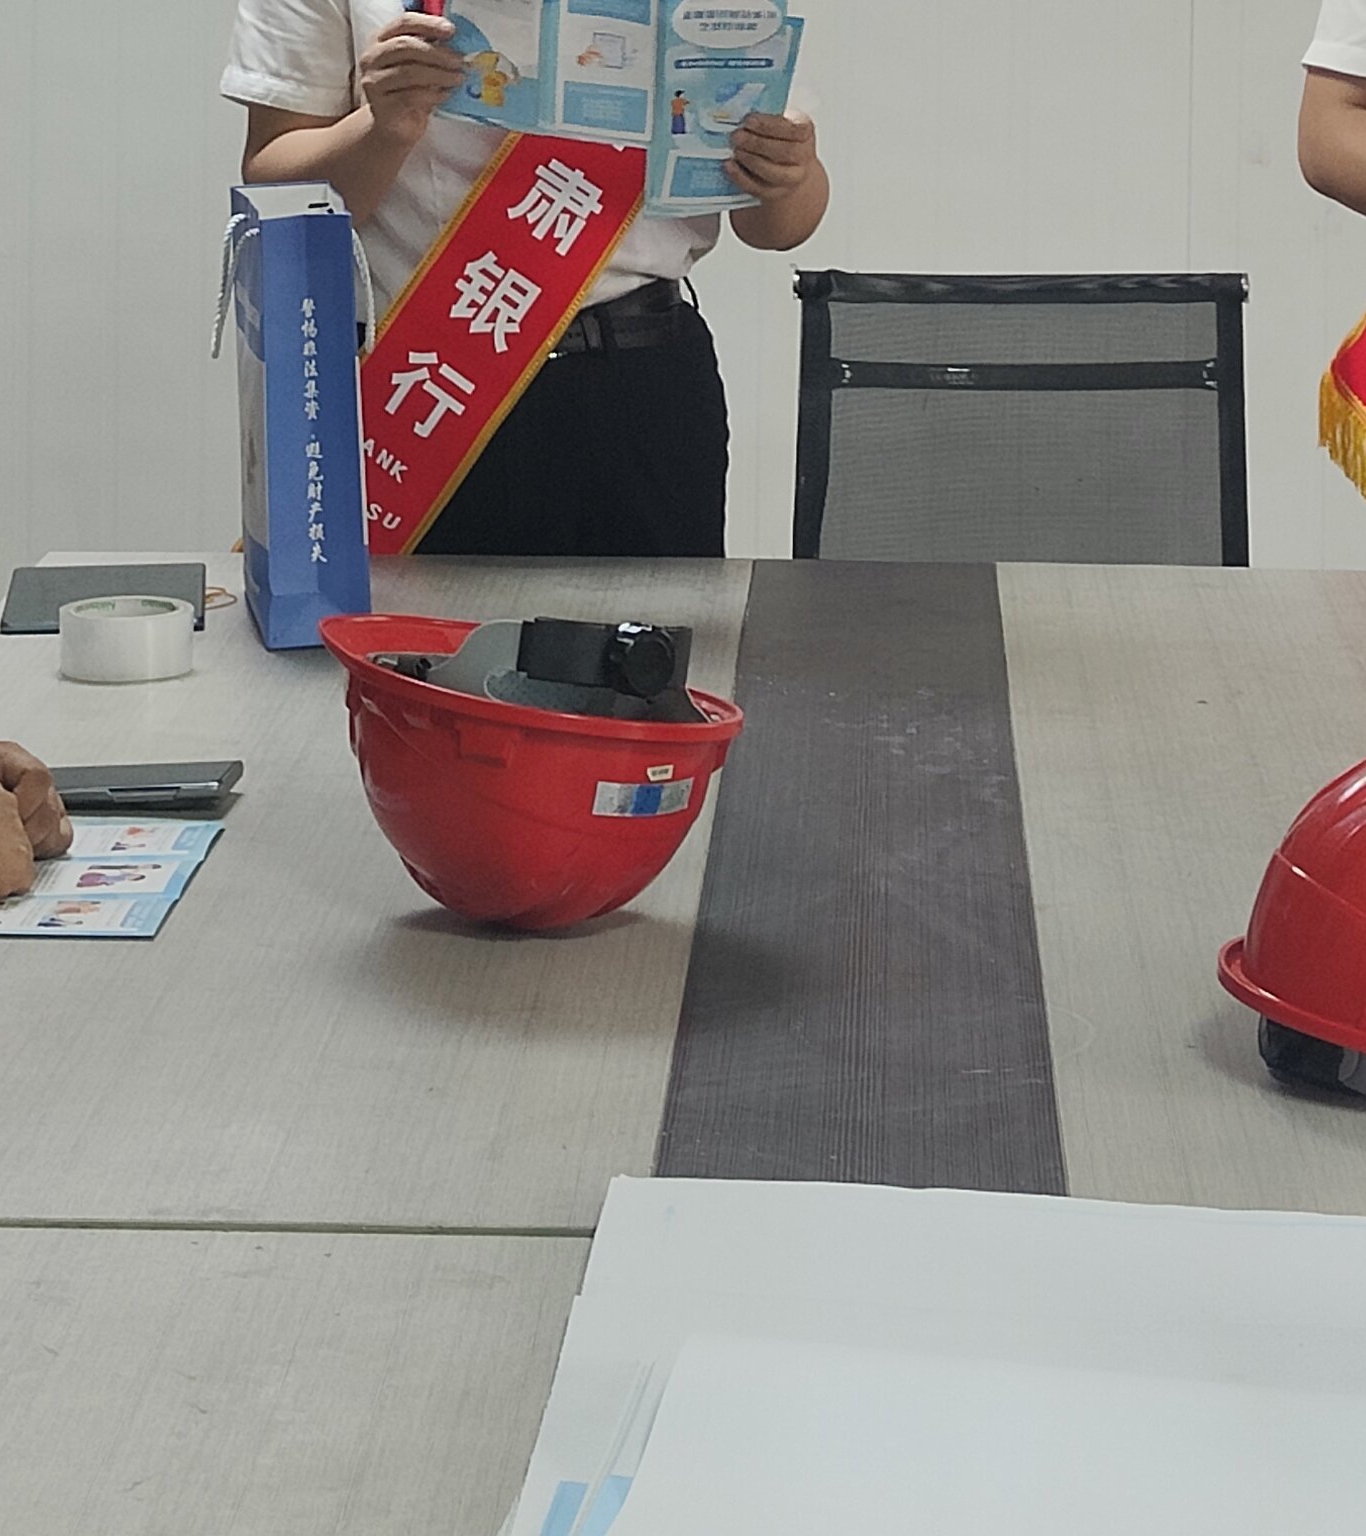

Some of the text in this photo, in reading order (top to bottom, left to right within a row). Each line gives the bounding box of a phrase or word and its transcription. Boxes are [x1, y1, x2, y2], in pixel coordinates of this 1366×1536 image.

[384, 157, 605, 439] 肃银行
[363, 437, 409, 484] ANK
